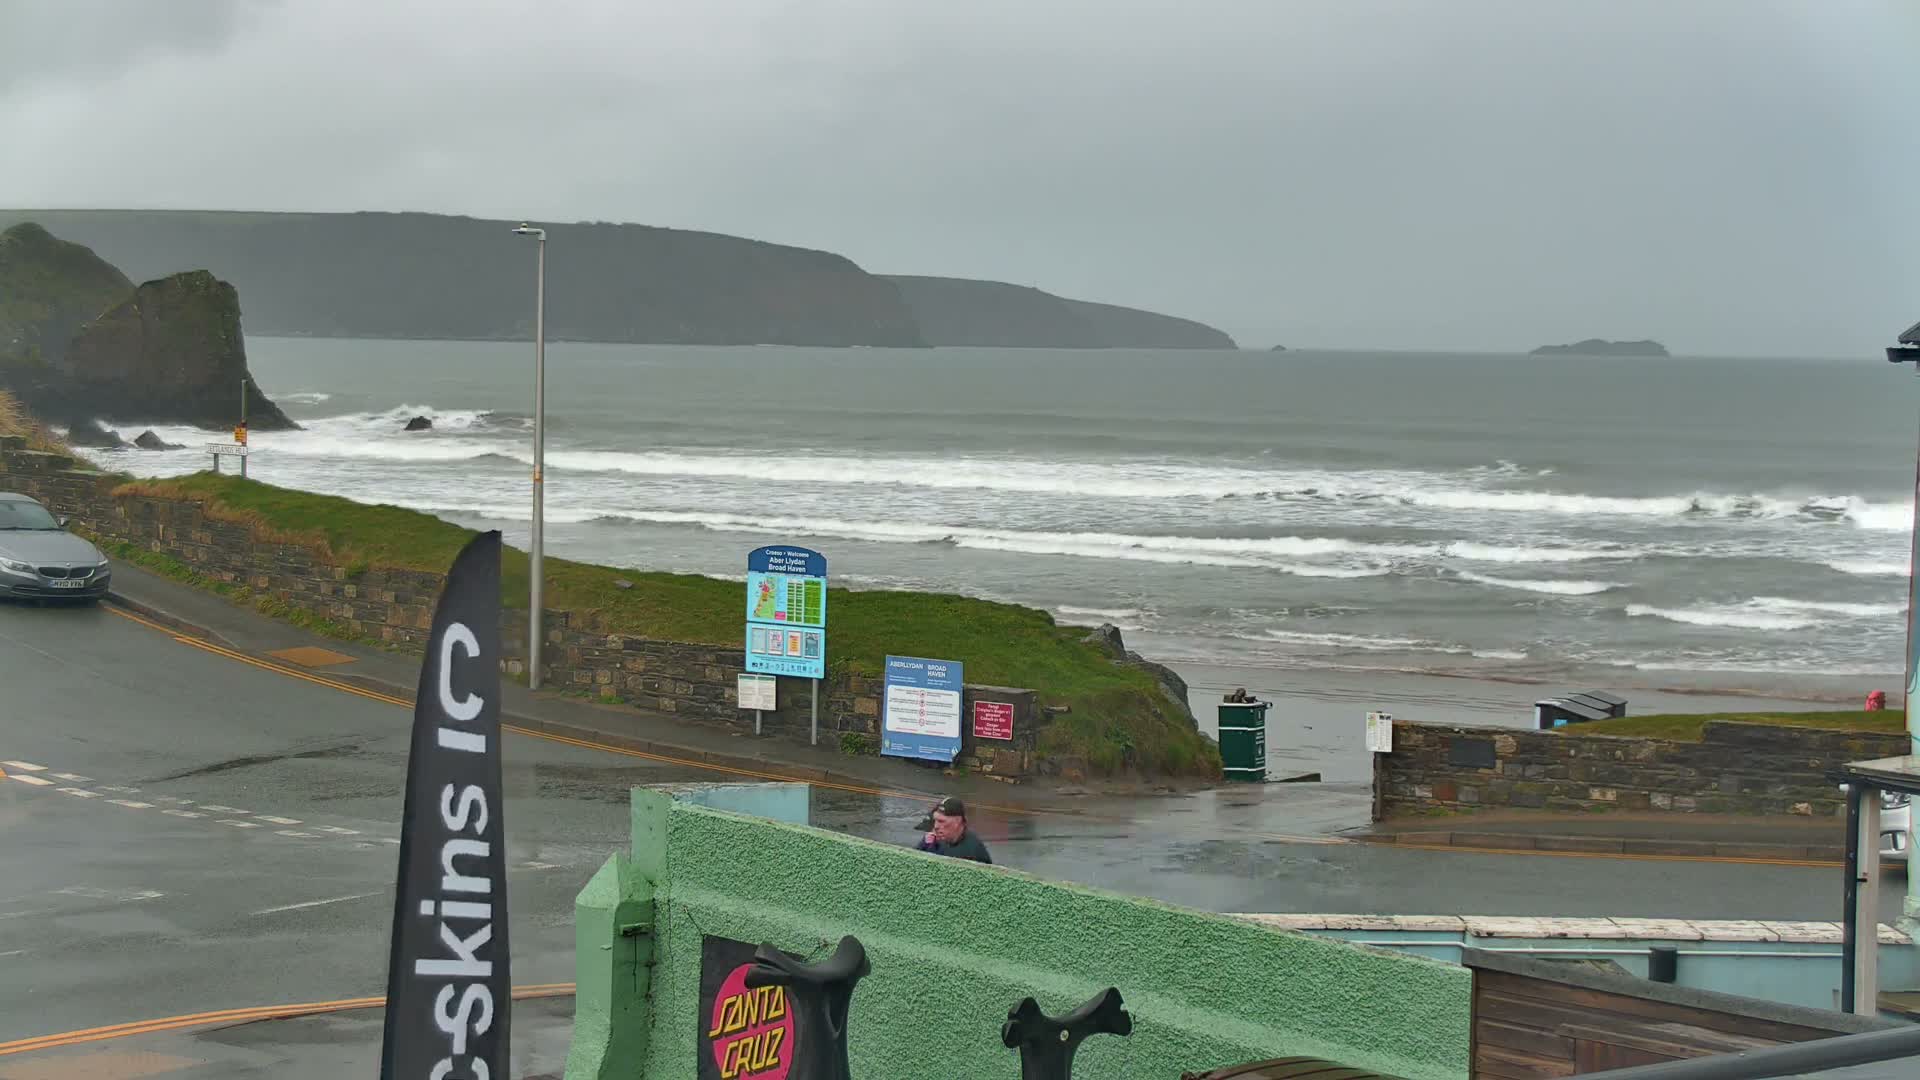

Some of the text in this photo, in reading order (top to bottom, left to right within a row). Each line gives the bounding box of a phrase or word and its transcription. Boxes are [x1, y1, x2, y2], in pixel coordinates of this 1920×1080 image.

[889, 661, 924, 669] ABERLLYDAN
[708, 985, 787, 1038] SANTA
[720, 1026, 786, 1079] CRUZ
